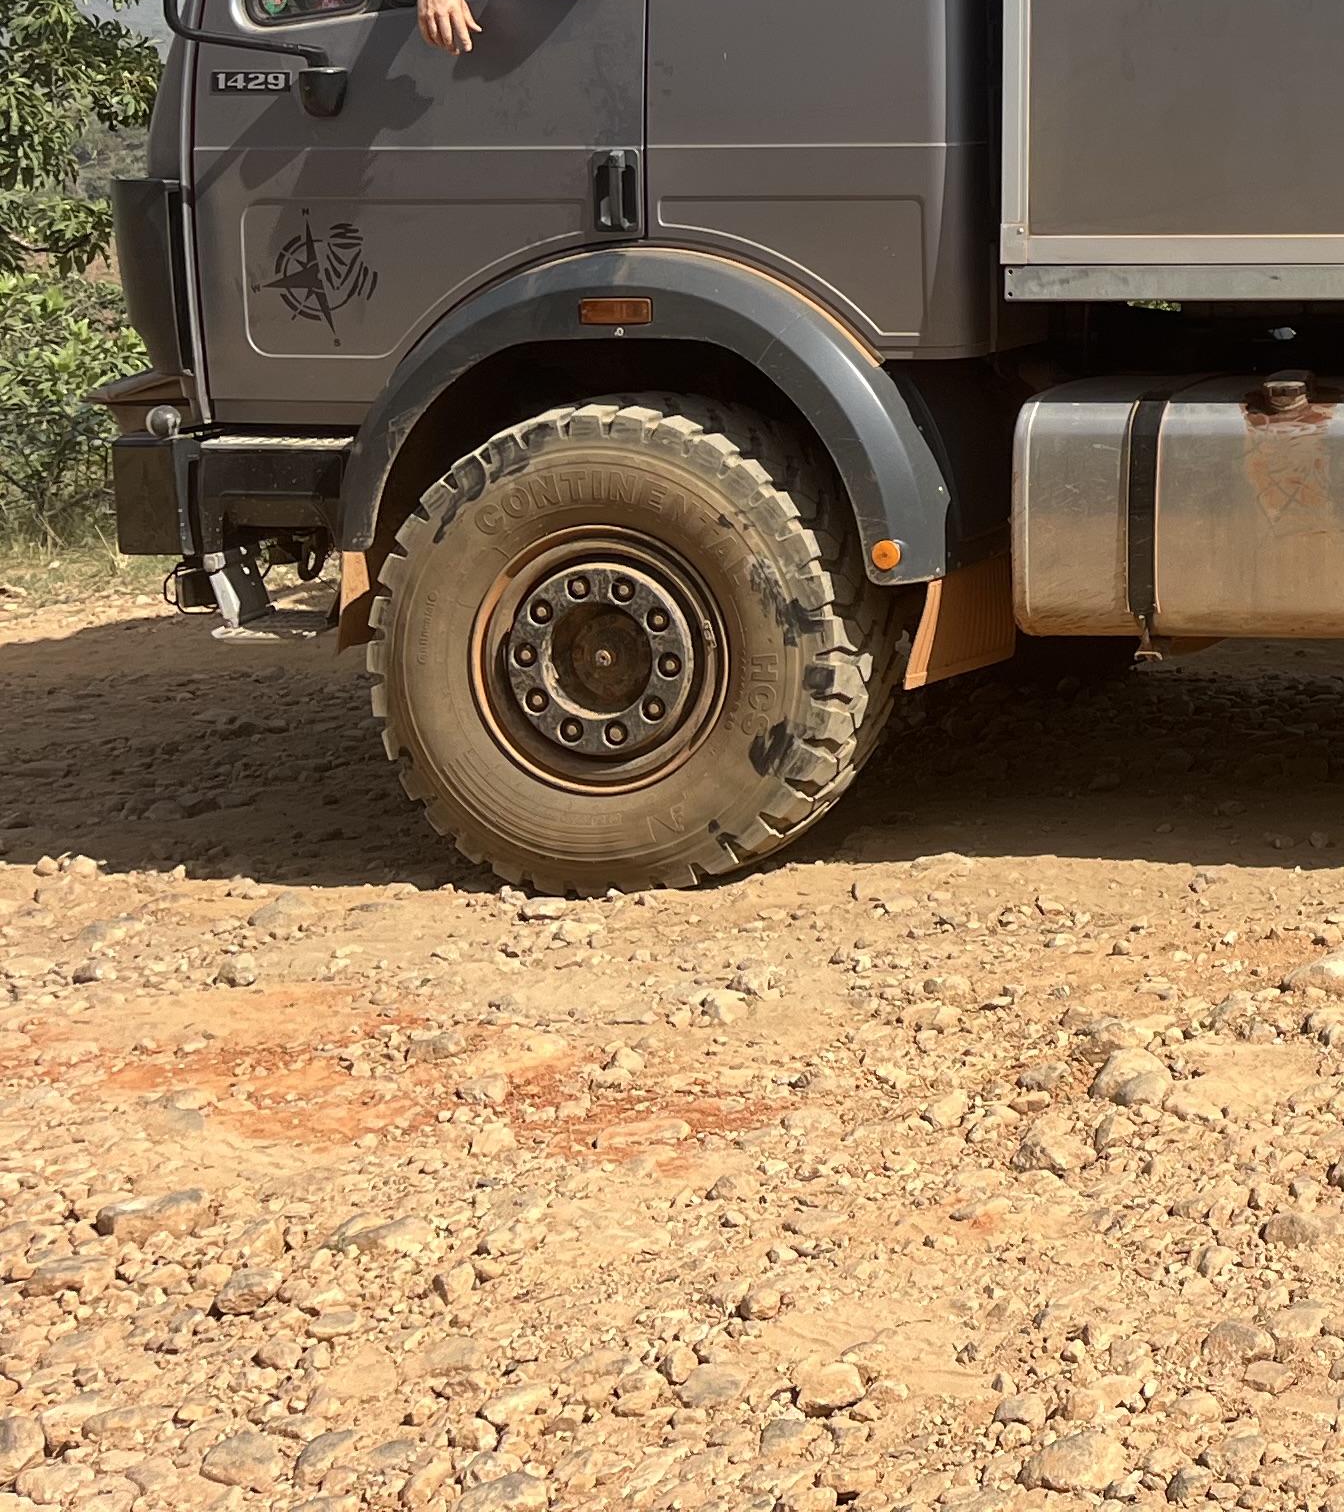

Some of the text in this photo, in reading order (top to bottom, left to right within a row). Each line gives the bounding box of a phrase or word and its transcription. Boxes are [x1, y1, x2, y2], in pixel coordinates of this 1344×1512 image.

[216, 72, 286, 90] 1429
[474, 469, 748, 587] CONTINENTAL
[740, 652, 778, 736] HCS
